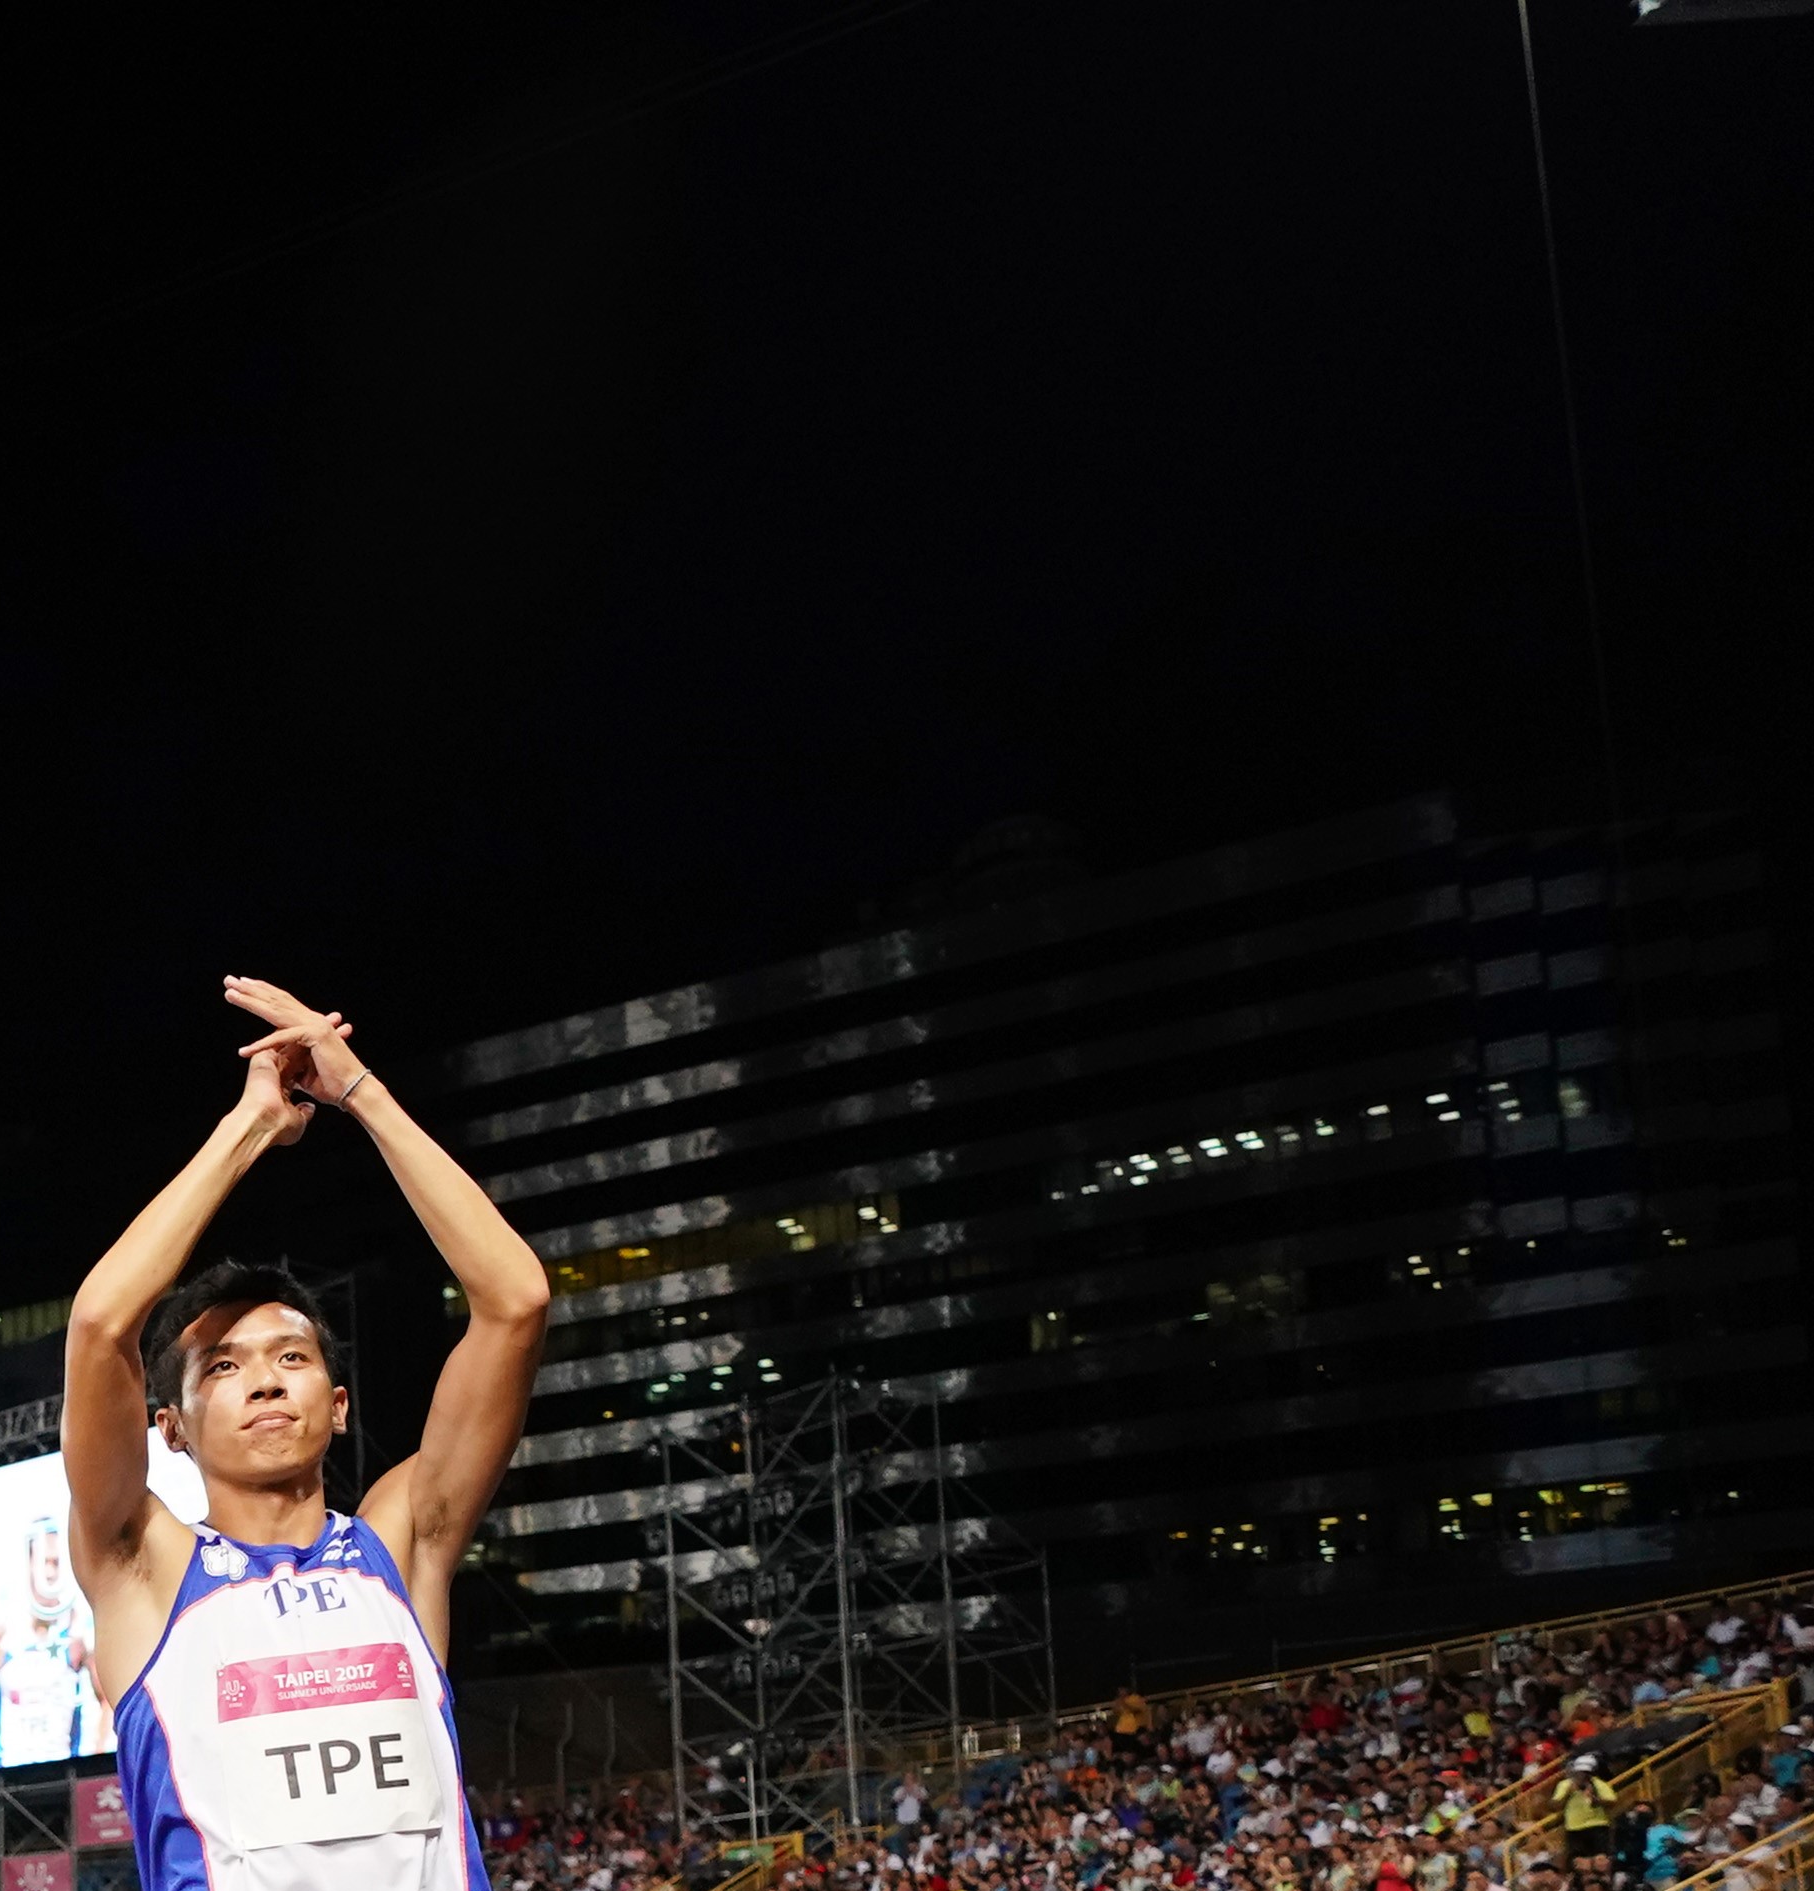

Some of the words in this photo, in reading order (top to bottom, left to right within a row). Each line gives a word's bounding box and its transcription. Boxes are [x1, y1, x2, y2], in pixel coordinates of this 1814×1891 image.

[274, 1668, 331, 1689] TAIPEI
[335, 1662, 374, 1683] 2017
[277, 1689, 318, 1701] SUMMER
[265, 1733, 411, 1800] TPE
